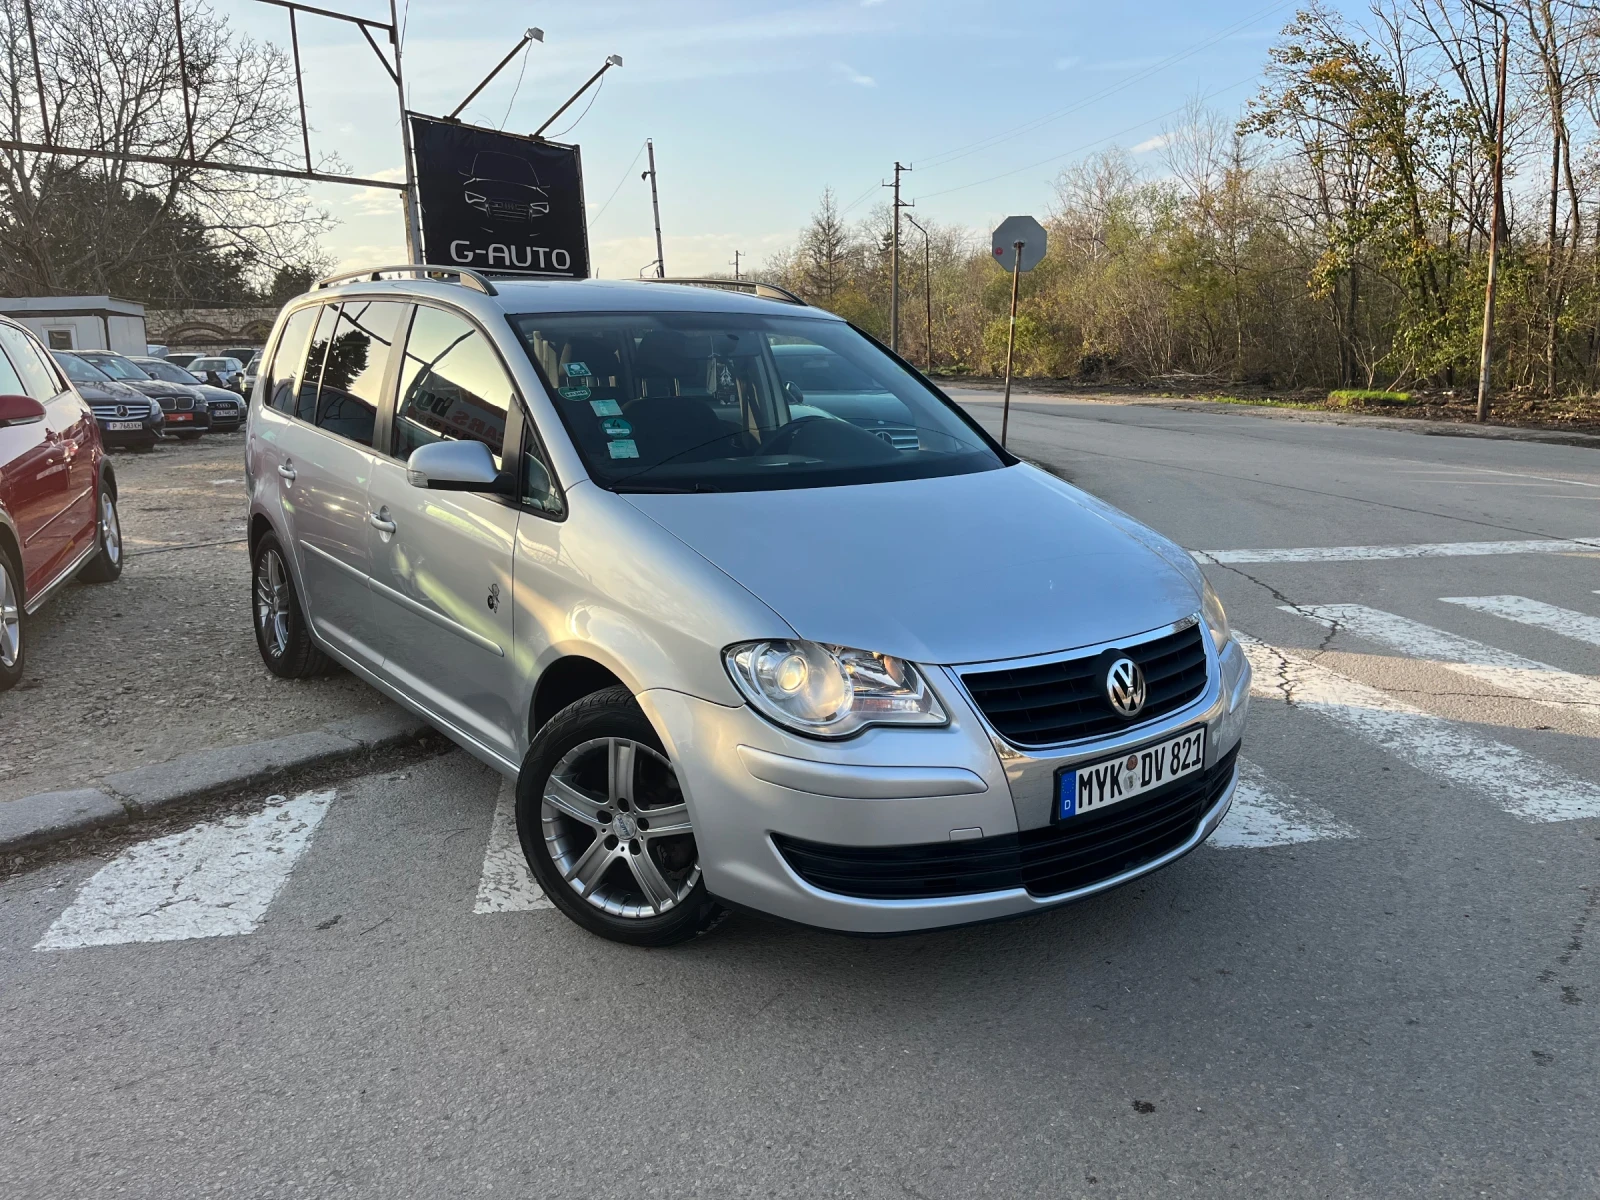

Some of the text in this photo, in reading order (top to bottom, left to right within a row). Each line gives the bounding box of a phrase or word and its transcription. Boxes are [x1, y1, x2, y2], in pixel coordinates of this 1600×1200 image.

[450, 239, 571, 270] G-AUTO
[1064, 732, 1202, 810] D MYK DV 821
